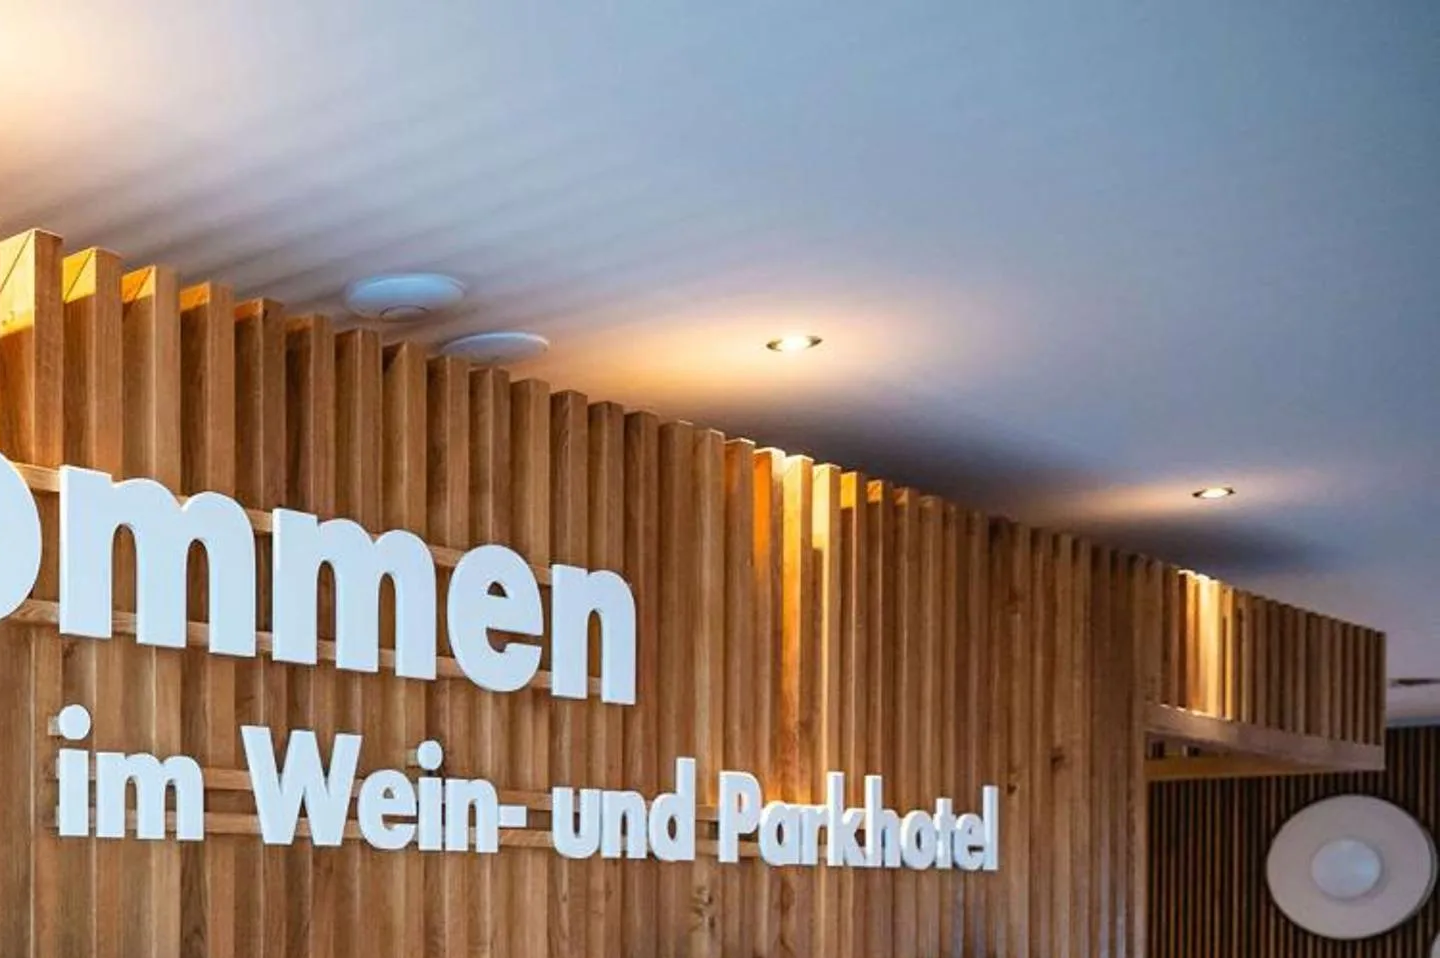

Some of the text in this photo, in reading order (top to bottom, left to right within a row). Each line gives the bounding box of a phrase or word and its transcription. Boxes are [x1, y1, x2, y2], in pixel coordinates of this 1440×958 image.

[56, 703, 999, 872] im Wein- und Parkhotel
